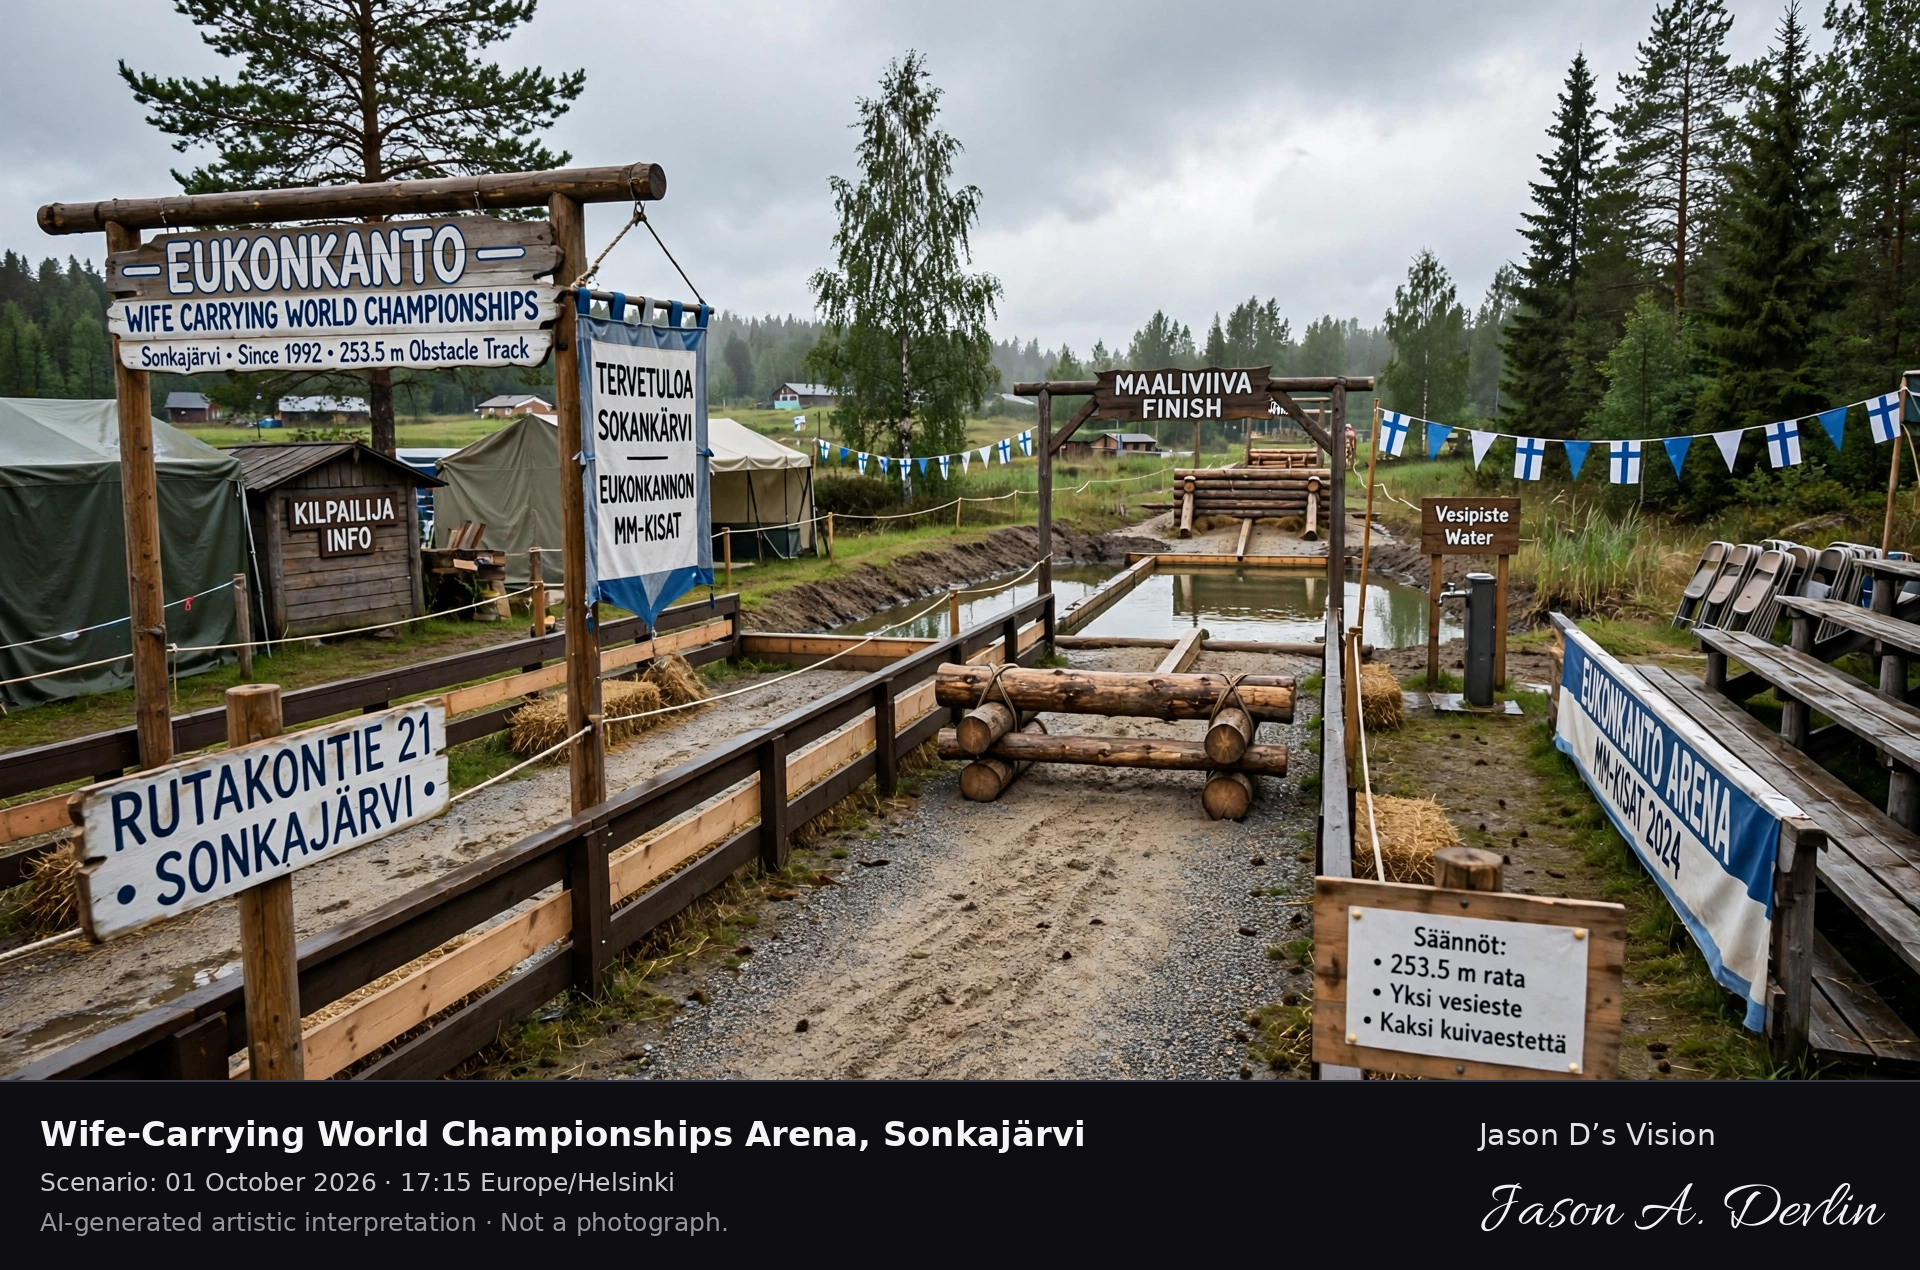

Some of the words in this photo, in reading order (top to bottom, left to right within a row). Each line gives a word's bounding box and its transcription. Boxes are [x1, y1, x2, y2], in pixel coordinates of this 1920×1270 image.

[166, 224, 466, 295] EUKONKANTO
[125, 304, 174, 332] WIFE
[180, 301, 278, 331] CARRYING
[285, 297, 357, 328] WORLD
[364, 290, 539, 325] CHAMPIONSHIPS
[141, 346, 220, 371] Sonkajärvi
[238, 344, 279, 365] Since
[284, 342, 322, 364] 1992
[340, 341, 385, 363] 253.5
[390, 347, 404, 362] m
[409, 338, 478, 361] Obstacle
[483, 336, 529, 360] Track
[595, 361, 694, 399] TERVETULOA
[1114, 371, 1252, 396] MAALIVIIVA
[598, 407, 692, 442] SOKANKÄRVI
[1142, 398, 1222, 419] FINISH
[599, 473, 694, 504] EUKONKANNON
[294, 498, 395, 525] KILPAILIJA
[615, 512, 682, 545] MM-KISAT
[1435, 505, 1509, 526] Vesipiste
[327, 526, 372, 552] INFO
[1445, 528, 1493, 545] Water
[1581, 656, 1664, 787] EUKONKANTO
[1665, 741, 1730, 866] ARENA
[111, 723, 384, 852] RUTAKONTIE
[398, 711, 430, 763] 21
[1593, 736, 1645, 832] MM-KISAT
[1645, 800, 1681, 880] 2024
[155, 774, 413, 906] SONKAJÄRVI
[1414, 926, 1506, 955] Säännöt:
[1391, 954, 1450, 979] 253.5
[1458, 966, 1476, 983] m
[1484, 969, 1526, 989] rata
[1390, 983, 1431, 1008] Yksi
[1440, 993, 1522, 1018] vesieste
[1380, 1011, 1433, 1038] Kaksi
[1441, 1018, 1566, 1055] kuivaestettä
